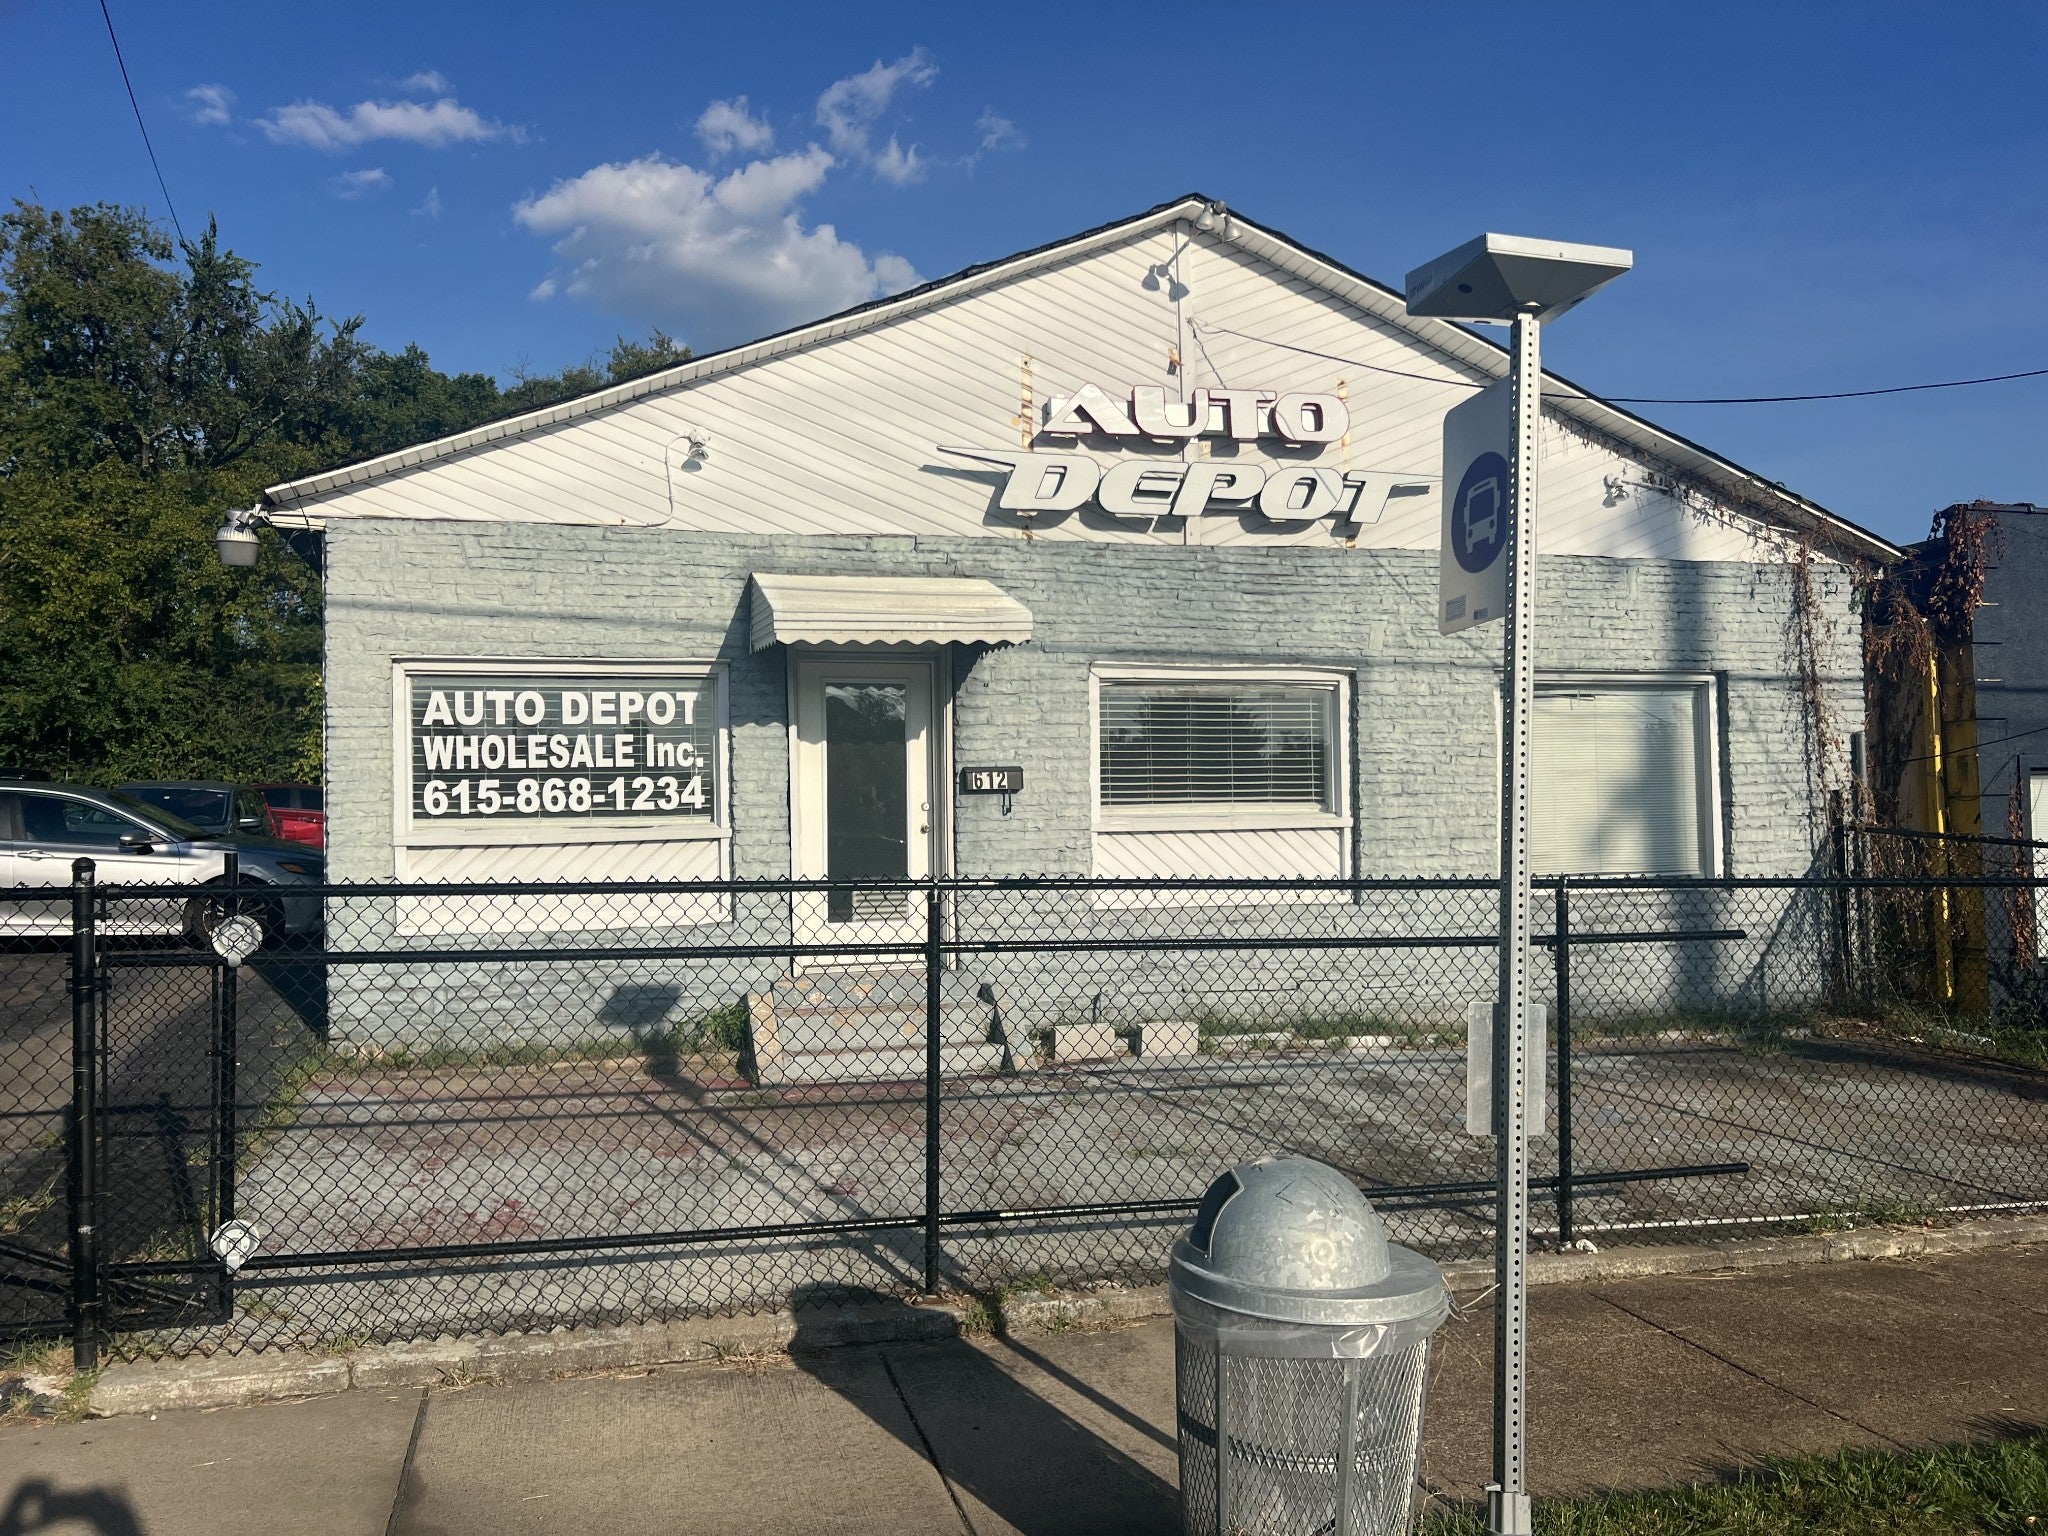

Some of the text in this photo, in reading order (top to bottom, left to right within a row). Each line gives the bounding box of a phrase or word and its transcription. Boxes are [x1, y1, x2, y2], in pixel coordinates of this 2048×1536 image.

[1043, 383, 1350, 442] AUTO
[937, 446, 1444, 524] DEPOT
[422, 691, 698, 725] AUTO DEPOT
[422, 734, 704, 770] WHOLESALE Inc.
[423, 776, 705, 815] 615-868-1234
[974, 772, 1007, 789] 612
